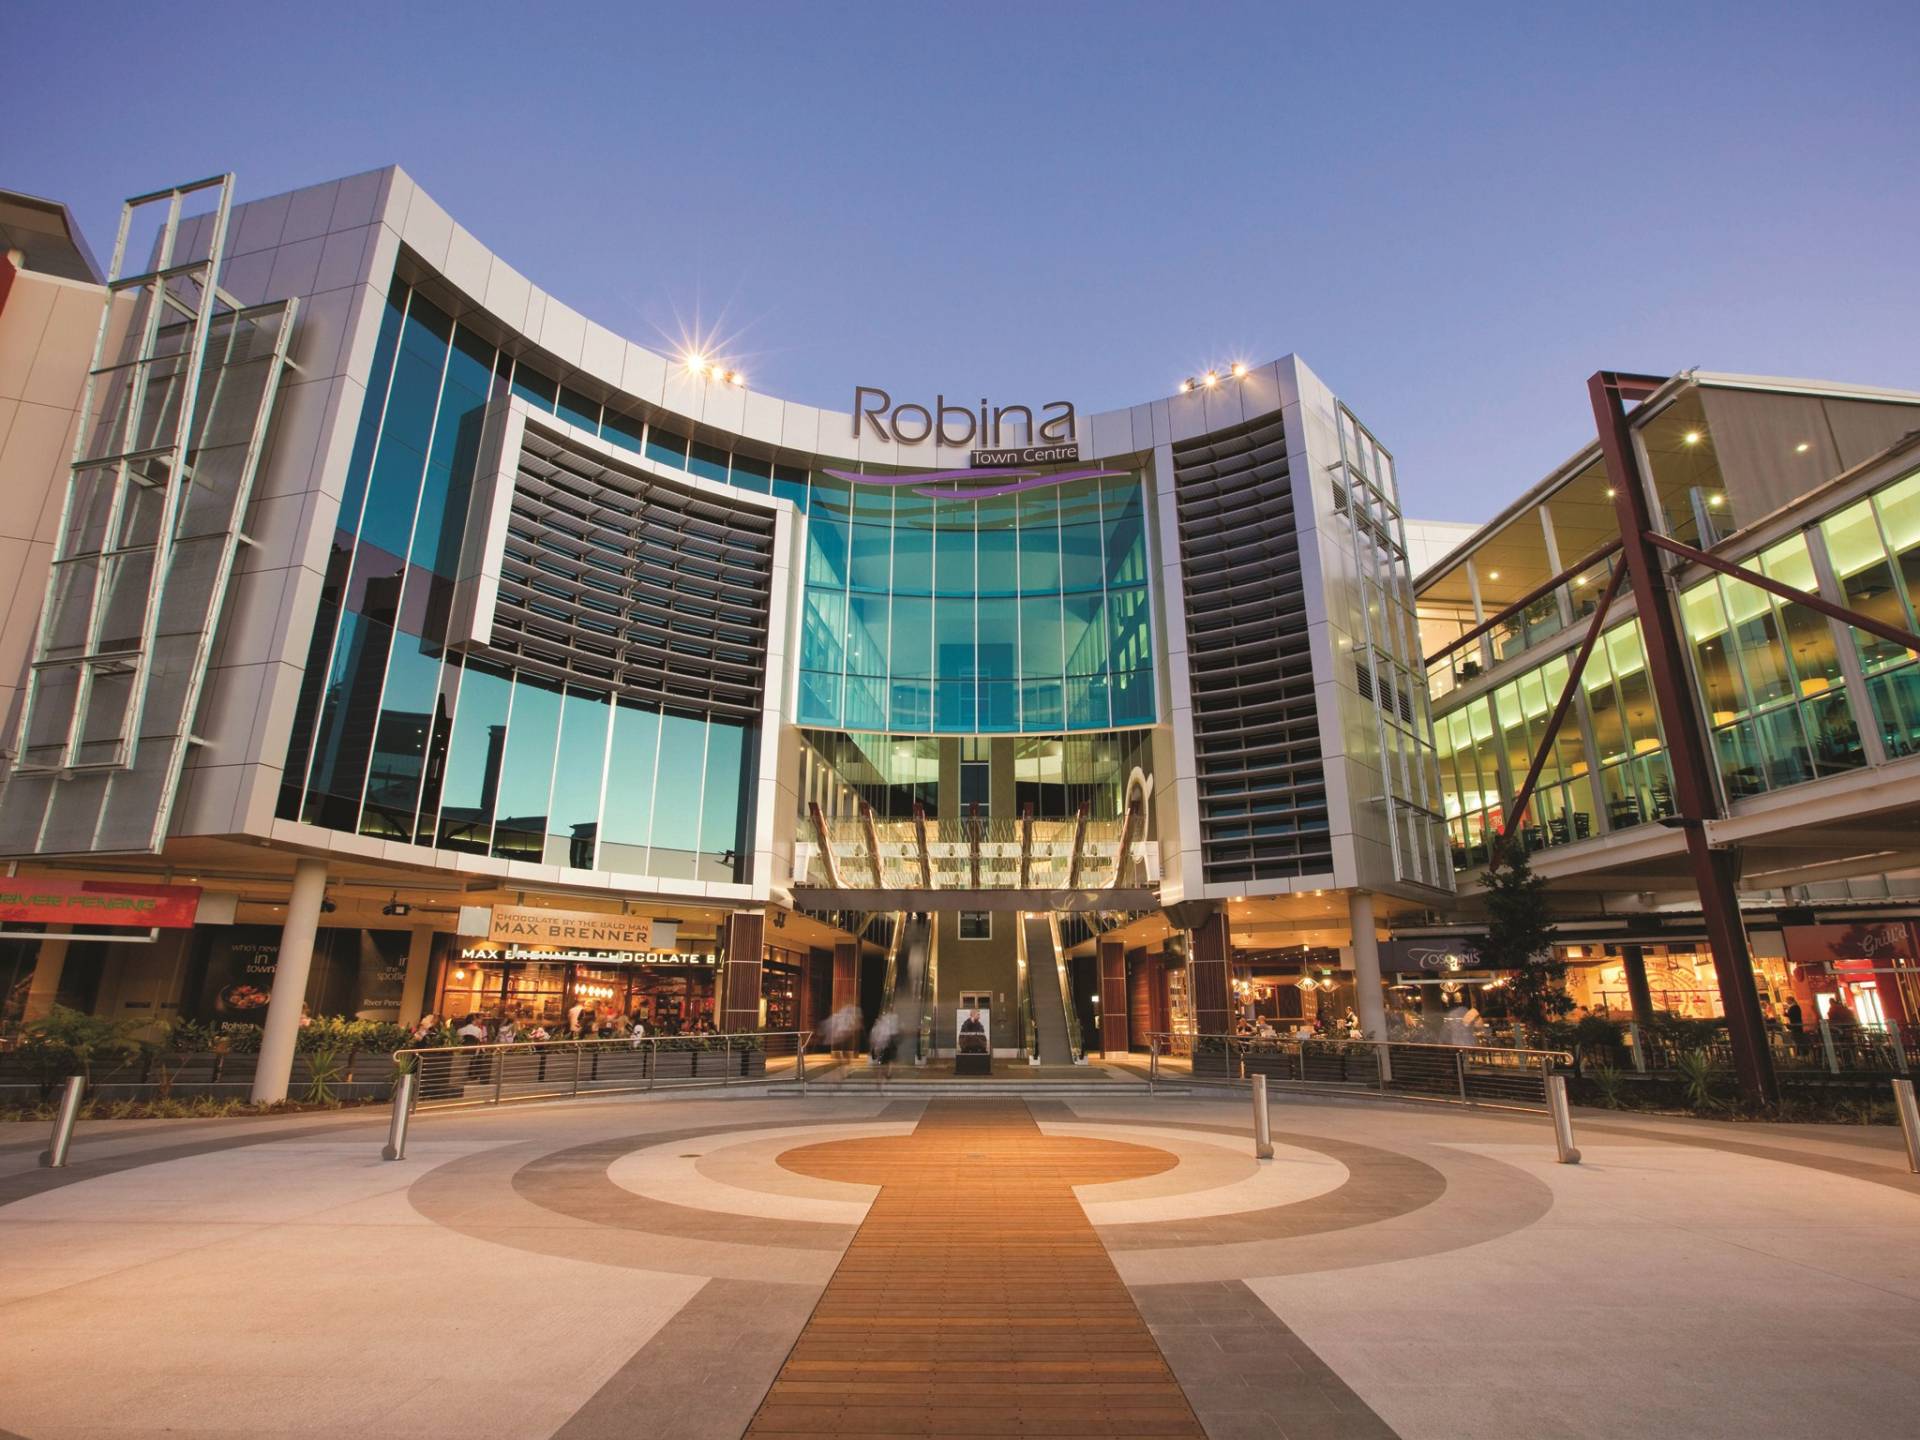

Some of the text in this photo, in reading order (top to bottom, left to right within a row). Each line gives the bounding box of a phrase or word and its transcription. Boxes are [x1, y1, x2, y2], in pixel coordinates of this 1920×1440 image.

[852, 385, 1076, 448] Robina
[973, 445, 1077, 465] Town Centre
[494, 922, 648, 943] MAX BRENNER
[496, 913, 560, 925] CHOCOLATE
[578, 920, 598, 928] THE
[600, 922, 625, 930] BALD
[628, 924, 649, 932] MAN
[461, 949, 498, 959] MAX
[596, 951, 699, 963] CHOCOLATE
